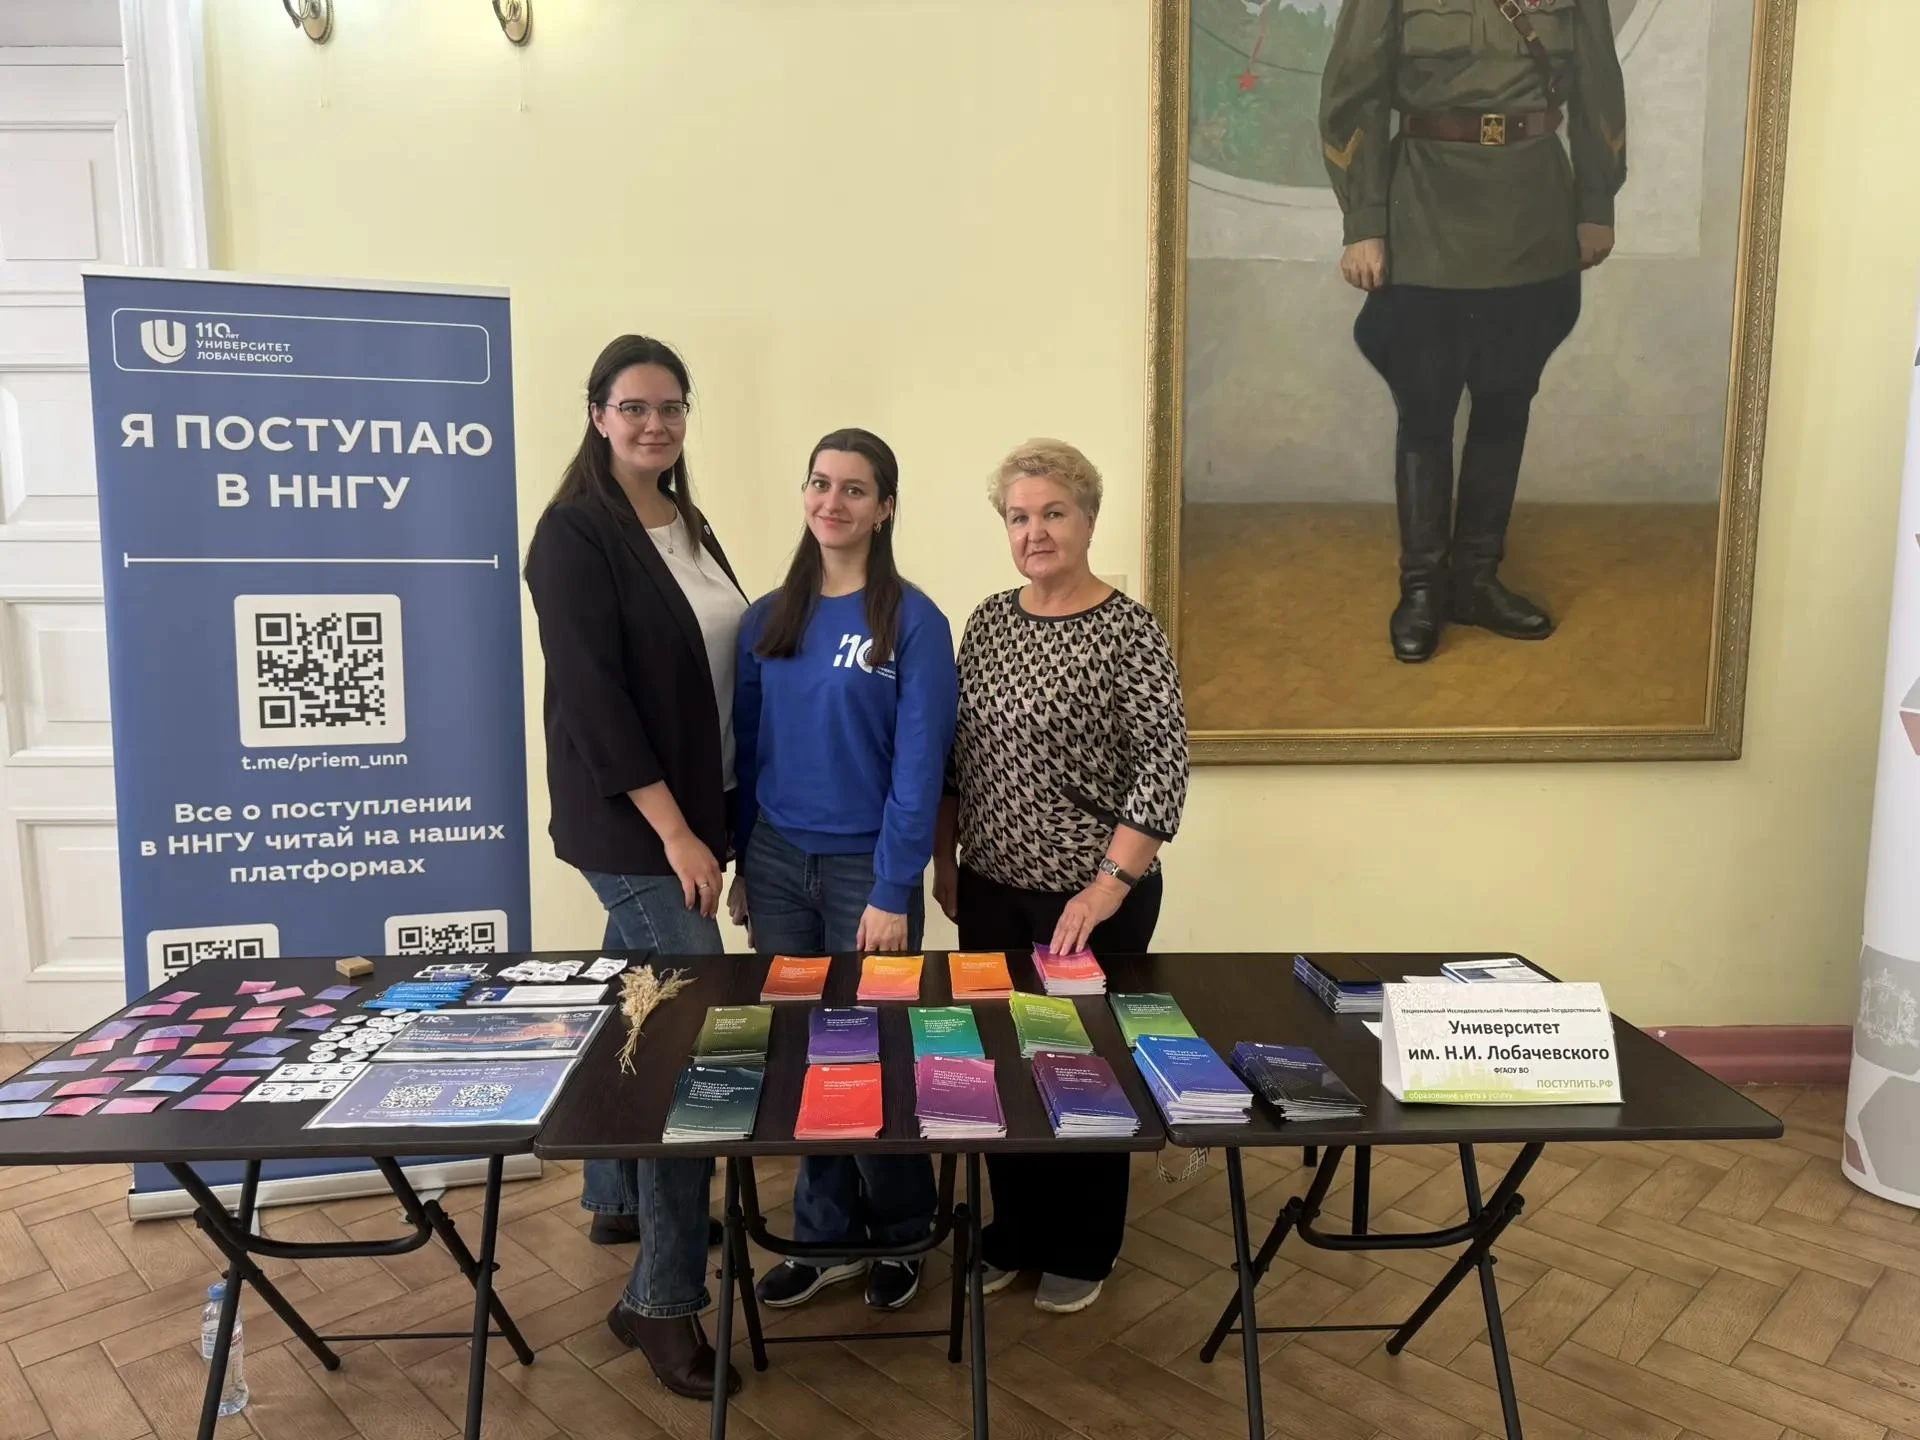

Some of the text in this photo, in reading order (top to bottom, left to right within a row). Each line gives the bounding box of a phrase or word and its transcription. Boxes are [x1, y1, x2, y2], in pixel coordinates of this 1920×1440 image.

[196, 340, 291, 352] УНИВЕРСИТЕТ
[196, 351, 294, 363] ЛОБАЧЕВСКОГО
[120, 413, 493, 457] Я ПОСТУПАЮ
[217, 473, 410, 510] В ННГУ
[241, 752, 408, 772] t.me/priem_unn
[174, 796, 472, 823] Все о поступлении
[140, 824, 505, 857] в ННГУ читай на наших
[230, 858, 426, 884] платформах
[1447, 1007, 1504, 1015] Исследовательский
[1448, 1020, 1561, 1038] Университет
[1408, 1044, 1610, 1060] им. Н.И. Лобачевского
[1536, 1079, 1614, 1089] ПОСТУПИТЬ.РФ
